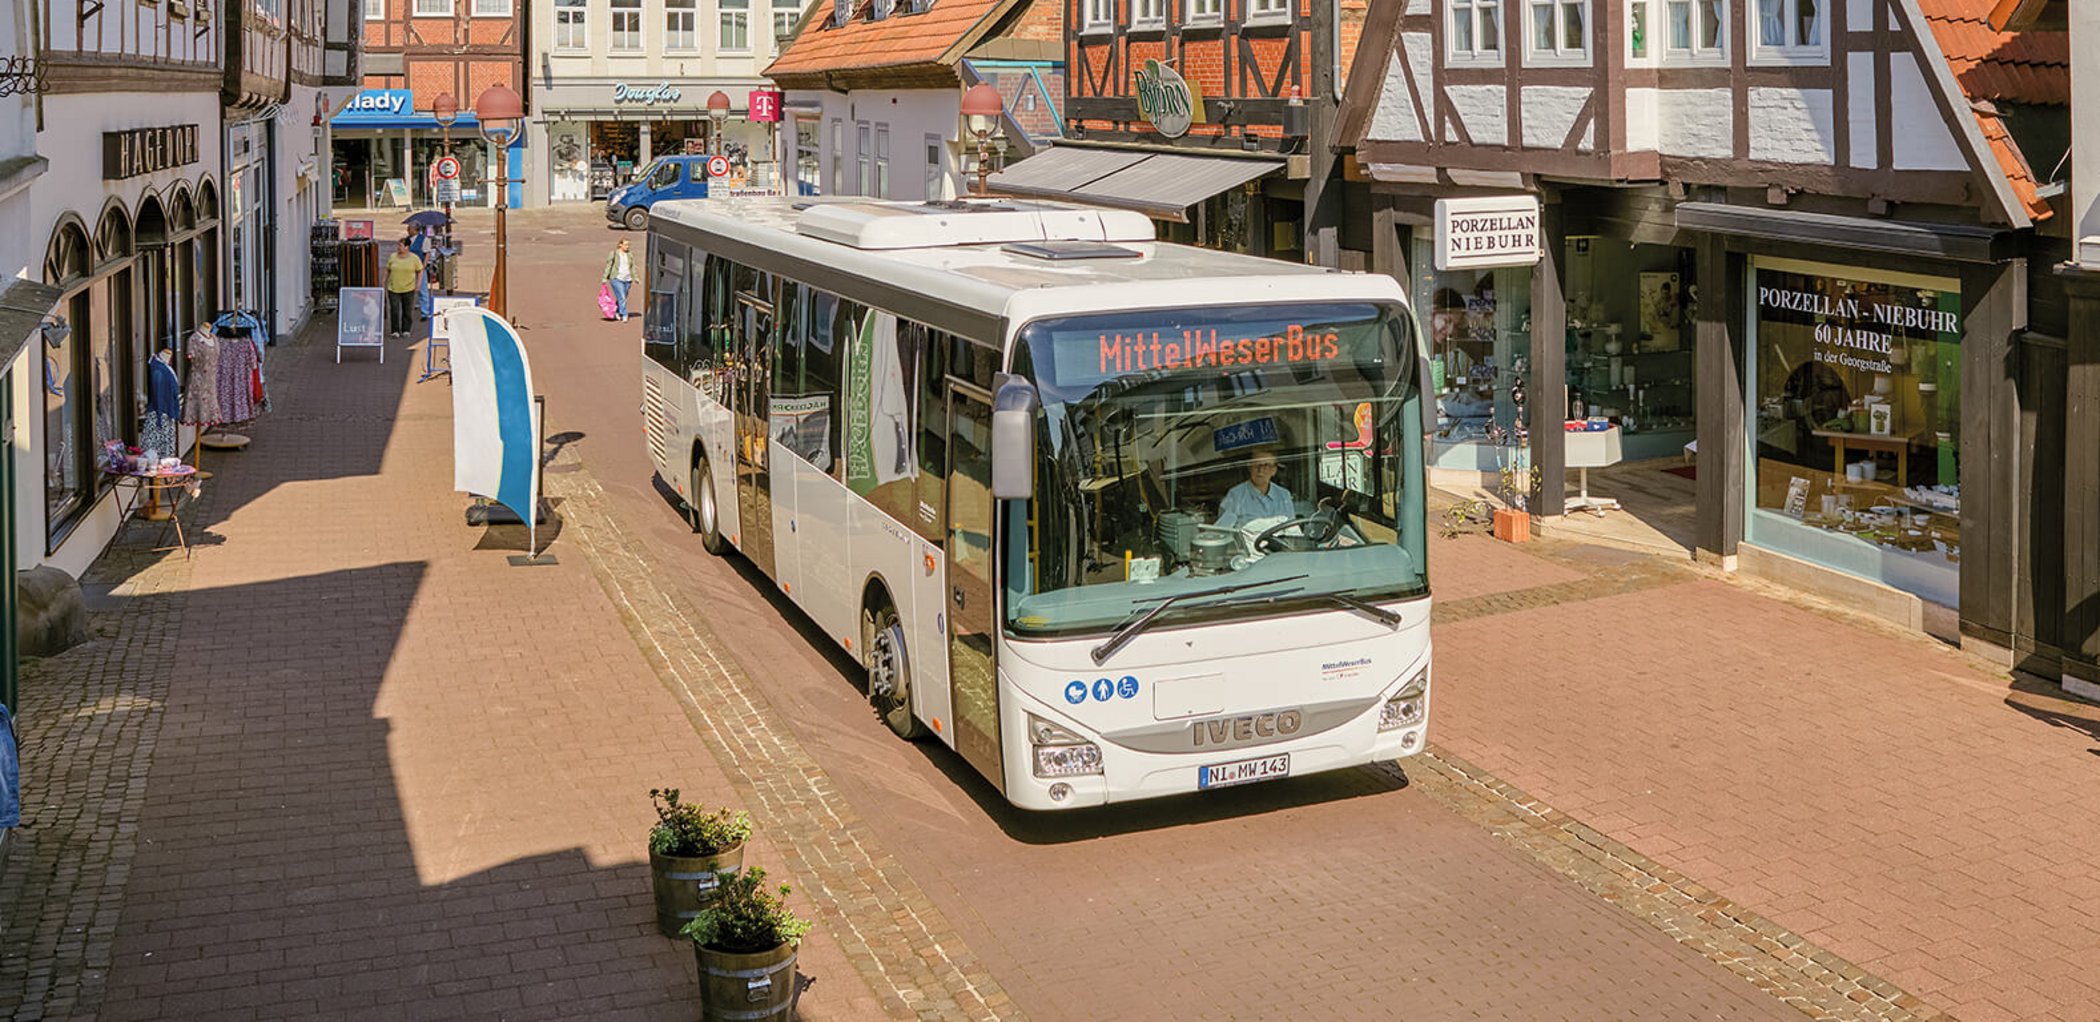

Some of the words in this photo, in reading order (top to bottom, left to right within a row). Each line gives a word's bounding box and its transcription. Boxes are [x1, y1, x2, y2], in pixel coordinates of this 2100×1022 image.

[347, 92, 405, 113] lady
[614, 80, 681, 104] Douglas
[1451, 216, 1535, 233] PORZELLAN
[1451, 234, 1535, 251] NIEBUHR
[1759, 287, 1859, 319] PORZELLAN
[1873, 303, 1959, 333] NIEBUHR
[343, 321, 366, 332] Lust
[1814, 323, 1832, 343] 60
[1834, 326, 1893, 354] JAHRE
[1099, 324, 1339, 373] MittelWeserBus
[1814, 348, 1823, 361] in
[1824, 350, 1838, 362] der
[1839, 352, 1892, 373] Georgstraße
[1193, 710, 1301, 746] IVECO
[1209, 767, 1227, 783] NI
[1238, 762, 1257, 778] MW
[1260, 758, 1287, 775] 143
